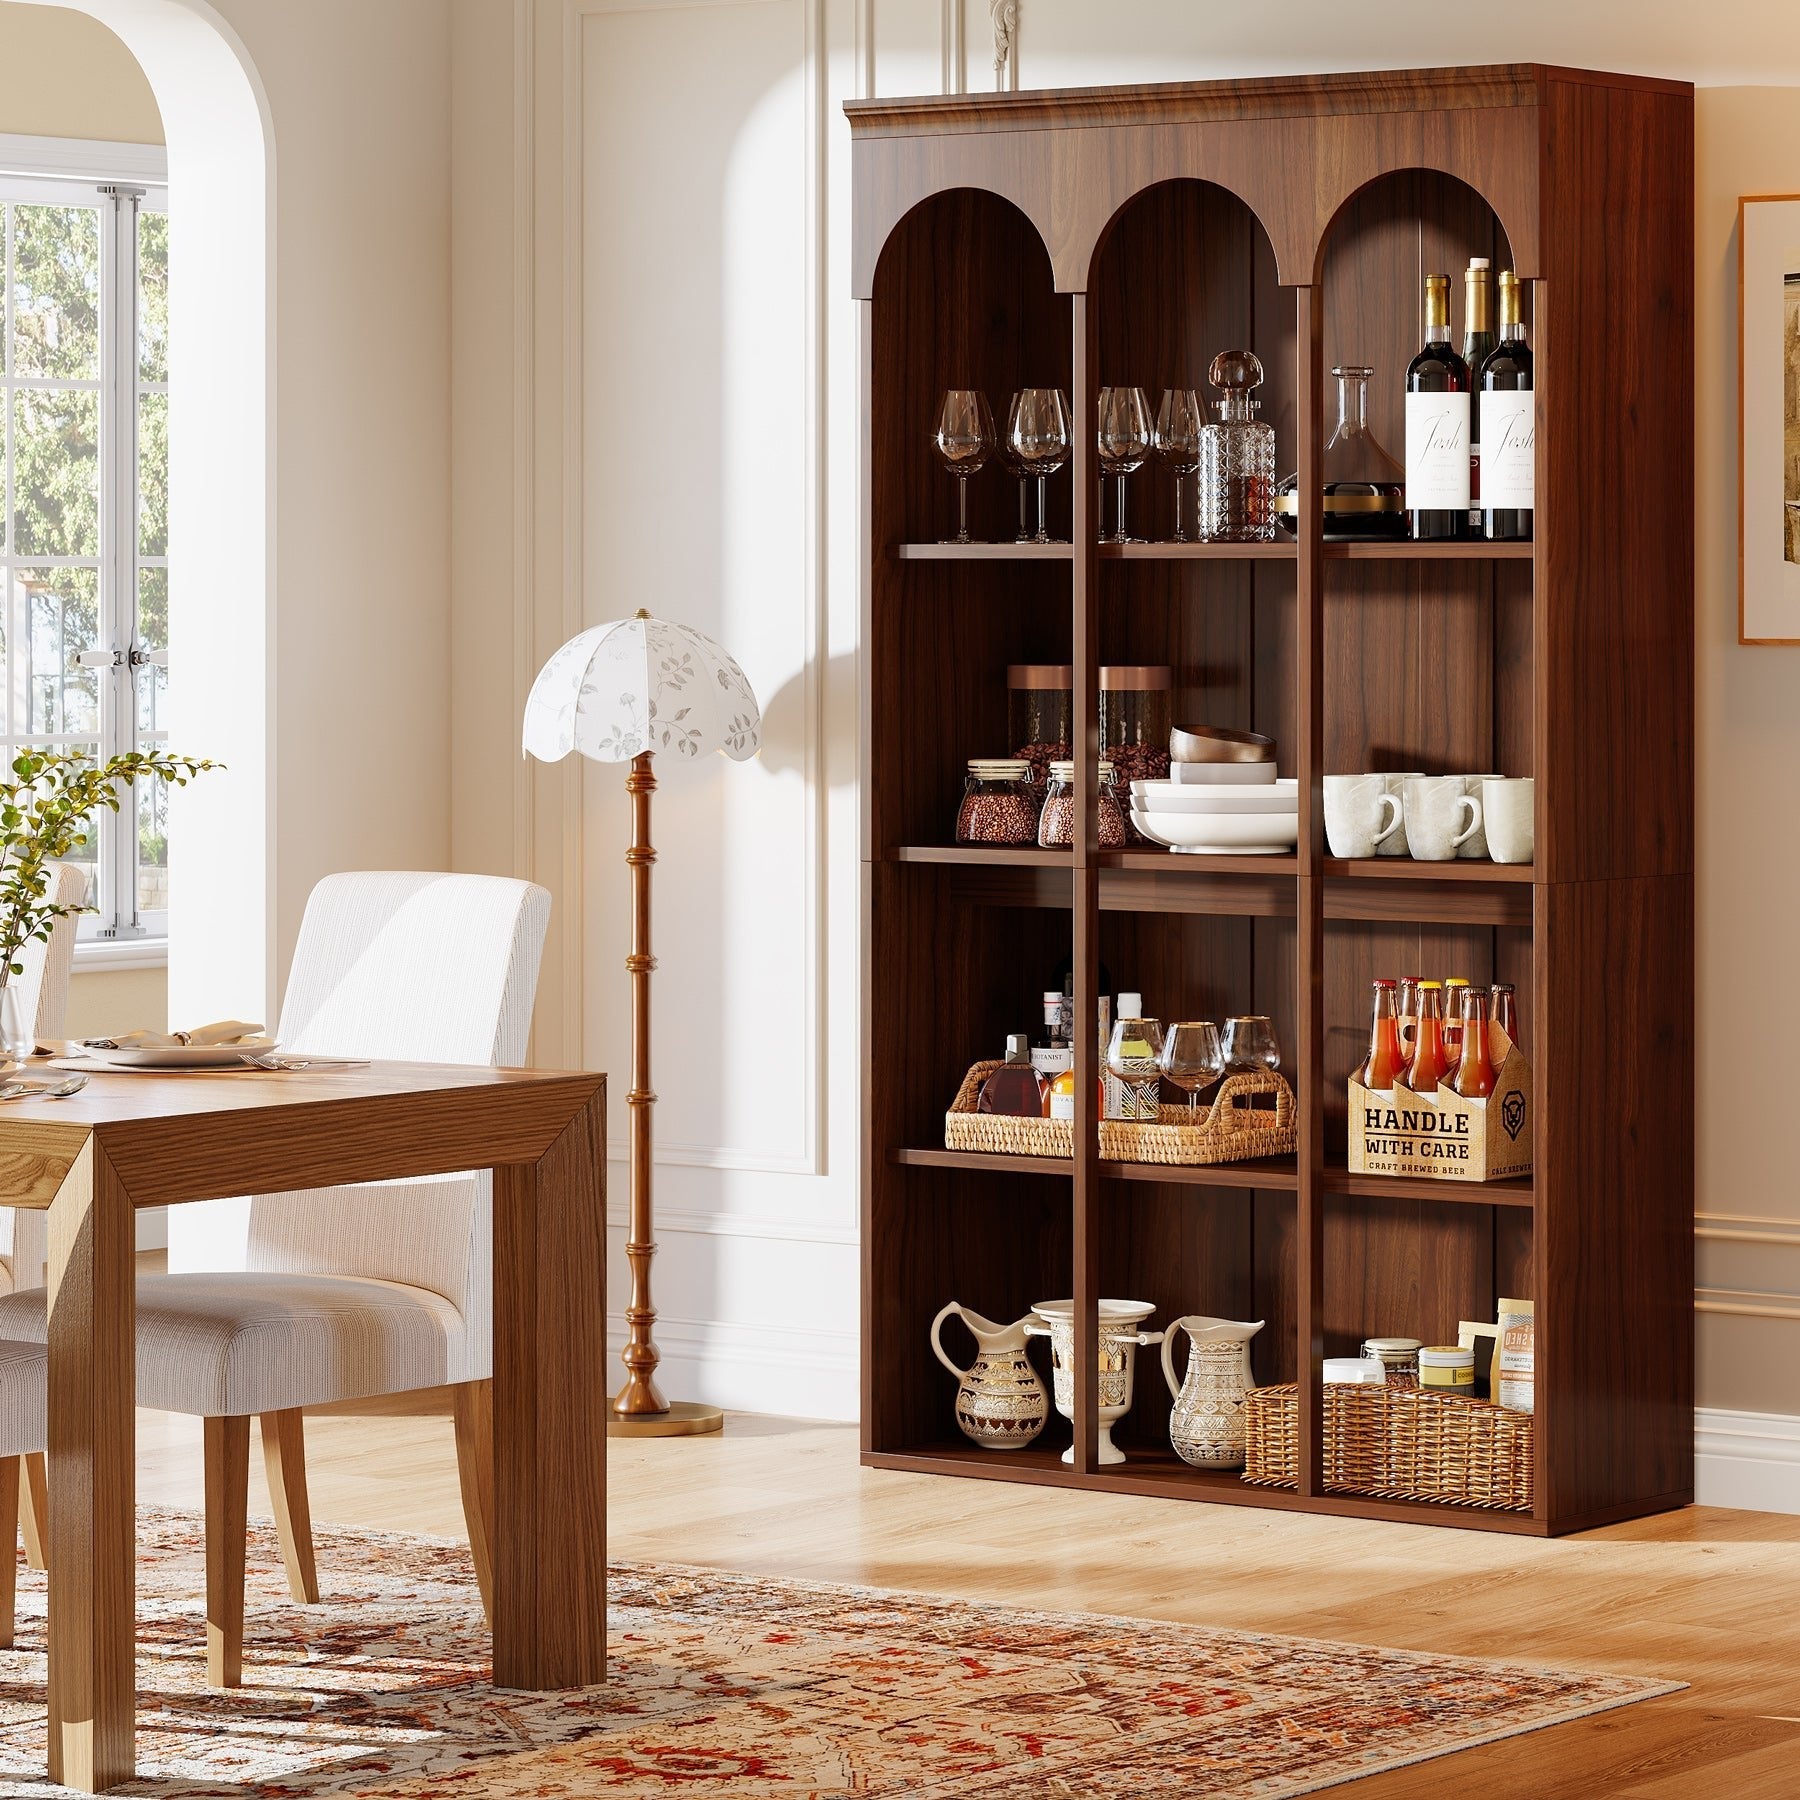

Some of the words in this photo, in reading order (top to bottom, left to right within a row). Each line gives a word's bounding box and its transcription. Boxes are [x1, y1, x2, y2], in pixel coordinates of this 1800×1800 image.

[1365, 1108, 1469, 1133] HANDLE
[1365, 1138, 1414, 1156] WITH
[1420, 1142, 1469, 1159] CARE
[1369, 1162, 1398, 1171] CRAFT
[1401, 1164, 1439, 1173] BREWED
[1442, 1167, 1465, 1175] BEER
